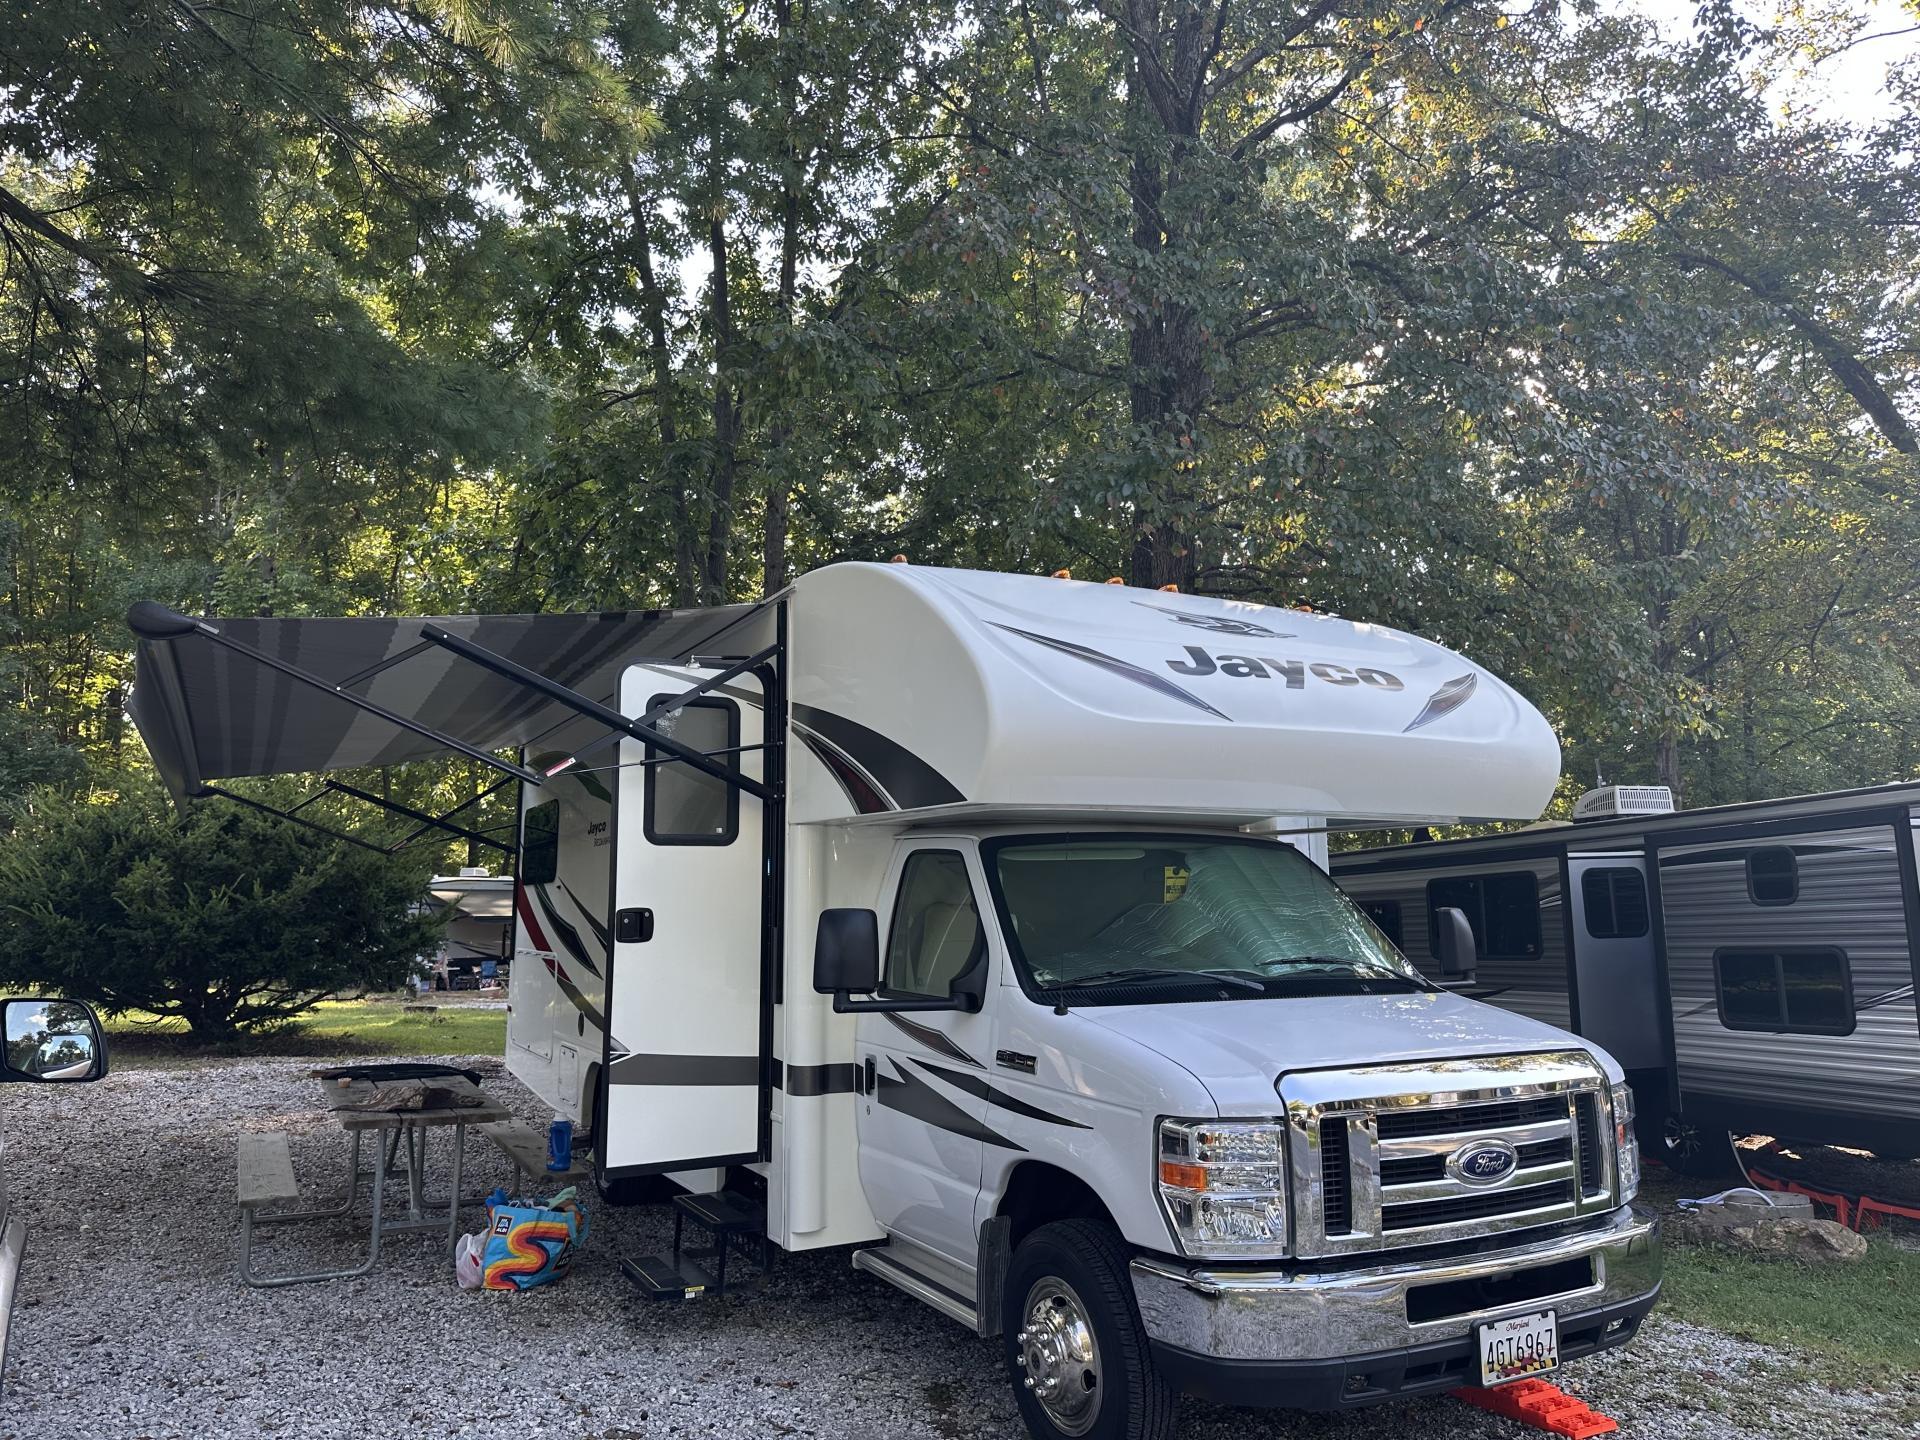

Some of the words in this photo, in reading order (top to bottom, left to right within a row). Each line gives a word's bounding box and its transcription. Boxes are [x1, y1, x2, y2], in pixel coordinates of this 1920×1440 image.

[1165, 645, 1405, 692] Jayco
[1475, 1152, 1505, 1173] Ford
[1505, 1318, 1530, 1332] Maryland
[1486, 1327, 1553, 1374] 4GT6967
